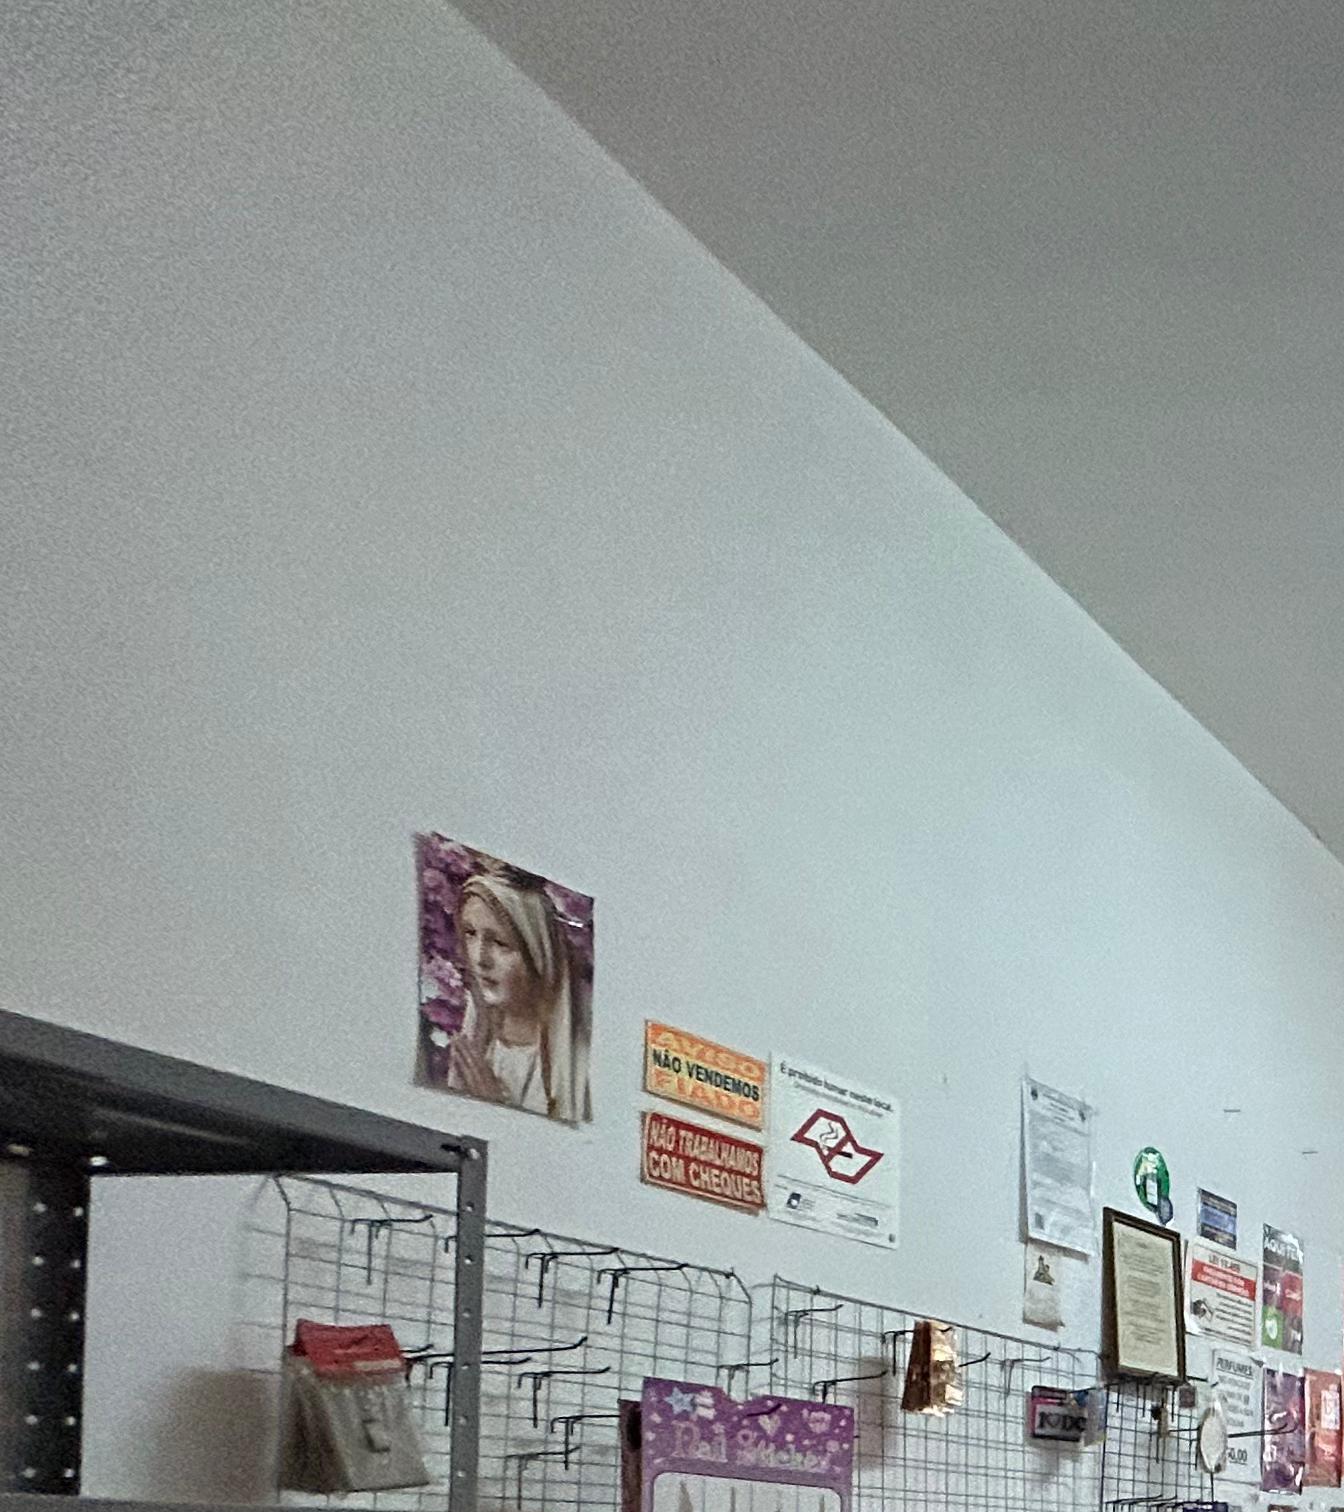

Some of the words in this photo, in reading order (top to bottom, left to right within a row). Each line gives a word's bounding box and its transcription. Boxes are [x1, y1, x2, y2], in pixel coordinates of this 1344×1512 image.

[652, 1048, 681, 1074] NÃO
[686, 1062, 760, 1102] VENDEMOS
[655, 1029, 761, 1078] AVISO
[654, 1070, 761, 1119] FIADO
[650, 1119, 675, 1150] NÃO
[679, 1128, 761, 1176] TRABALHAMOS
[649, 1152, 685, 1183] COM
[688, 1162, 762, 1201] CHEQUES
[1216, 1357, 1253, 1376] PERFUMES
